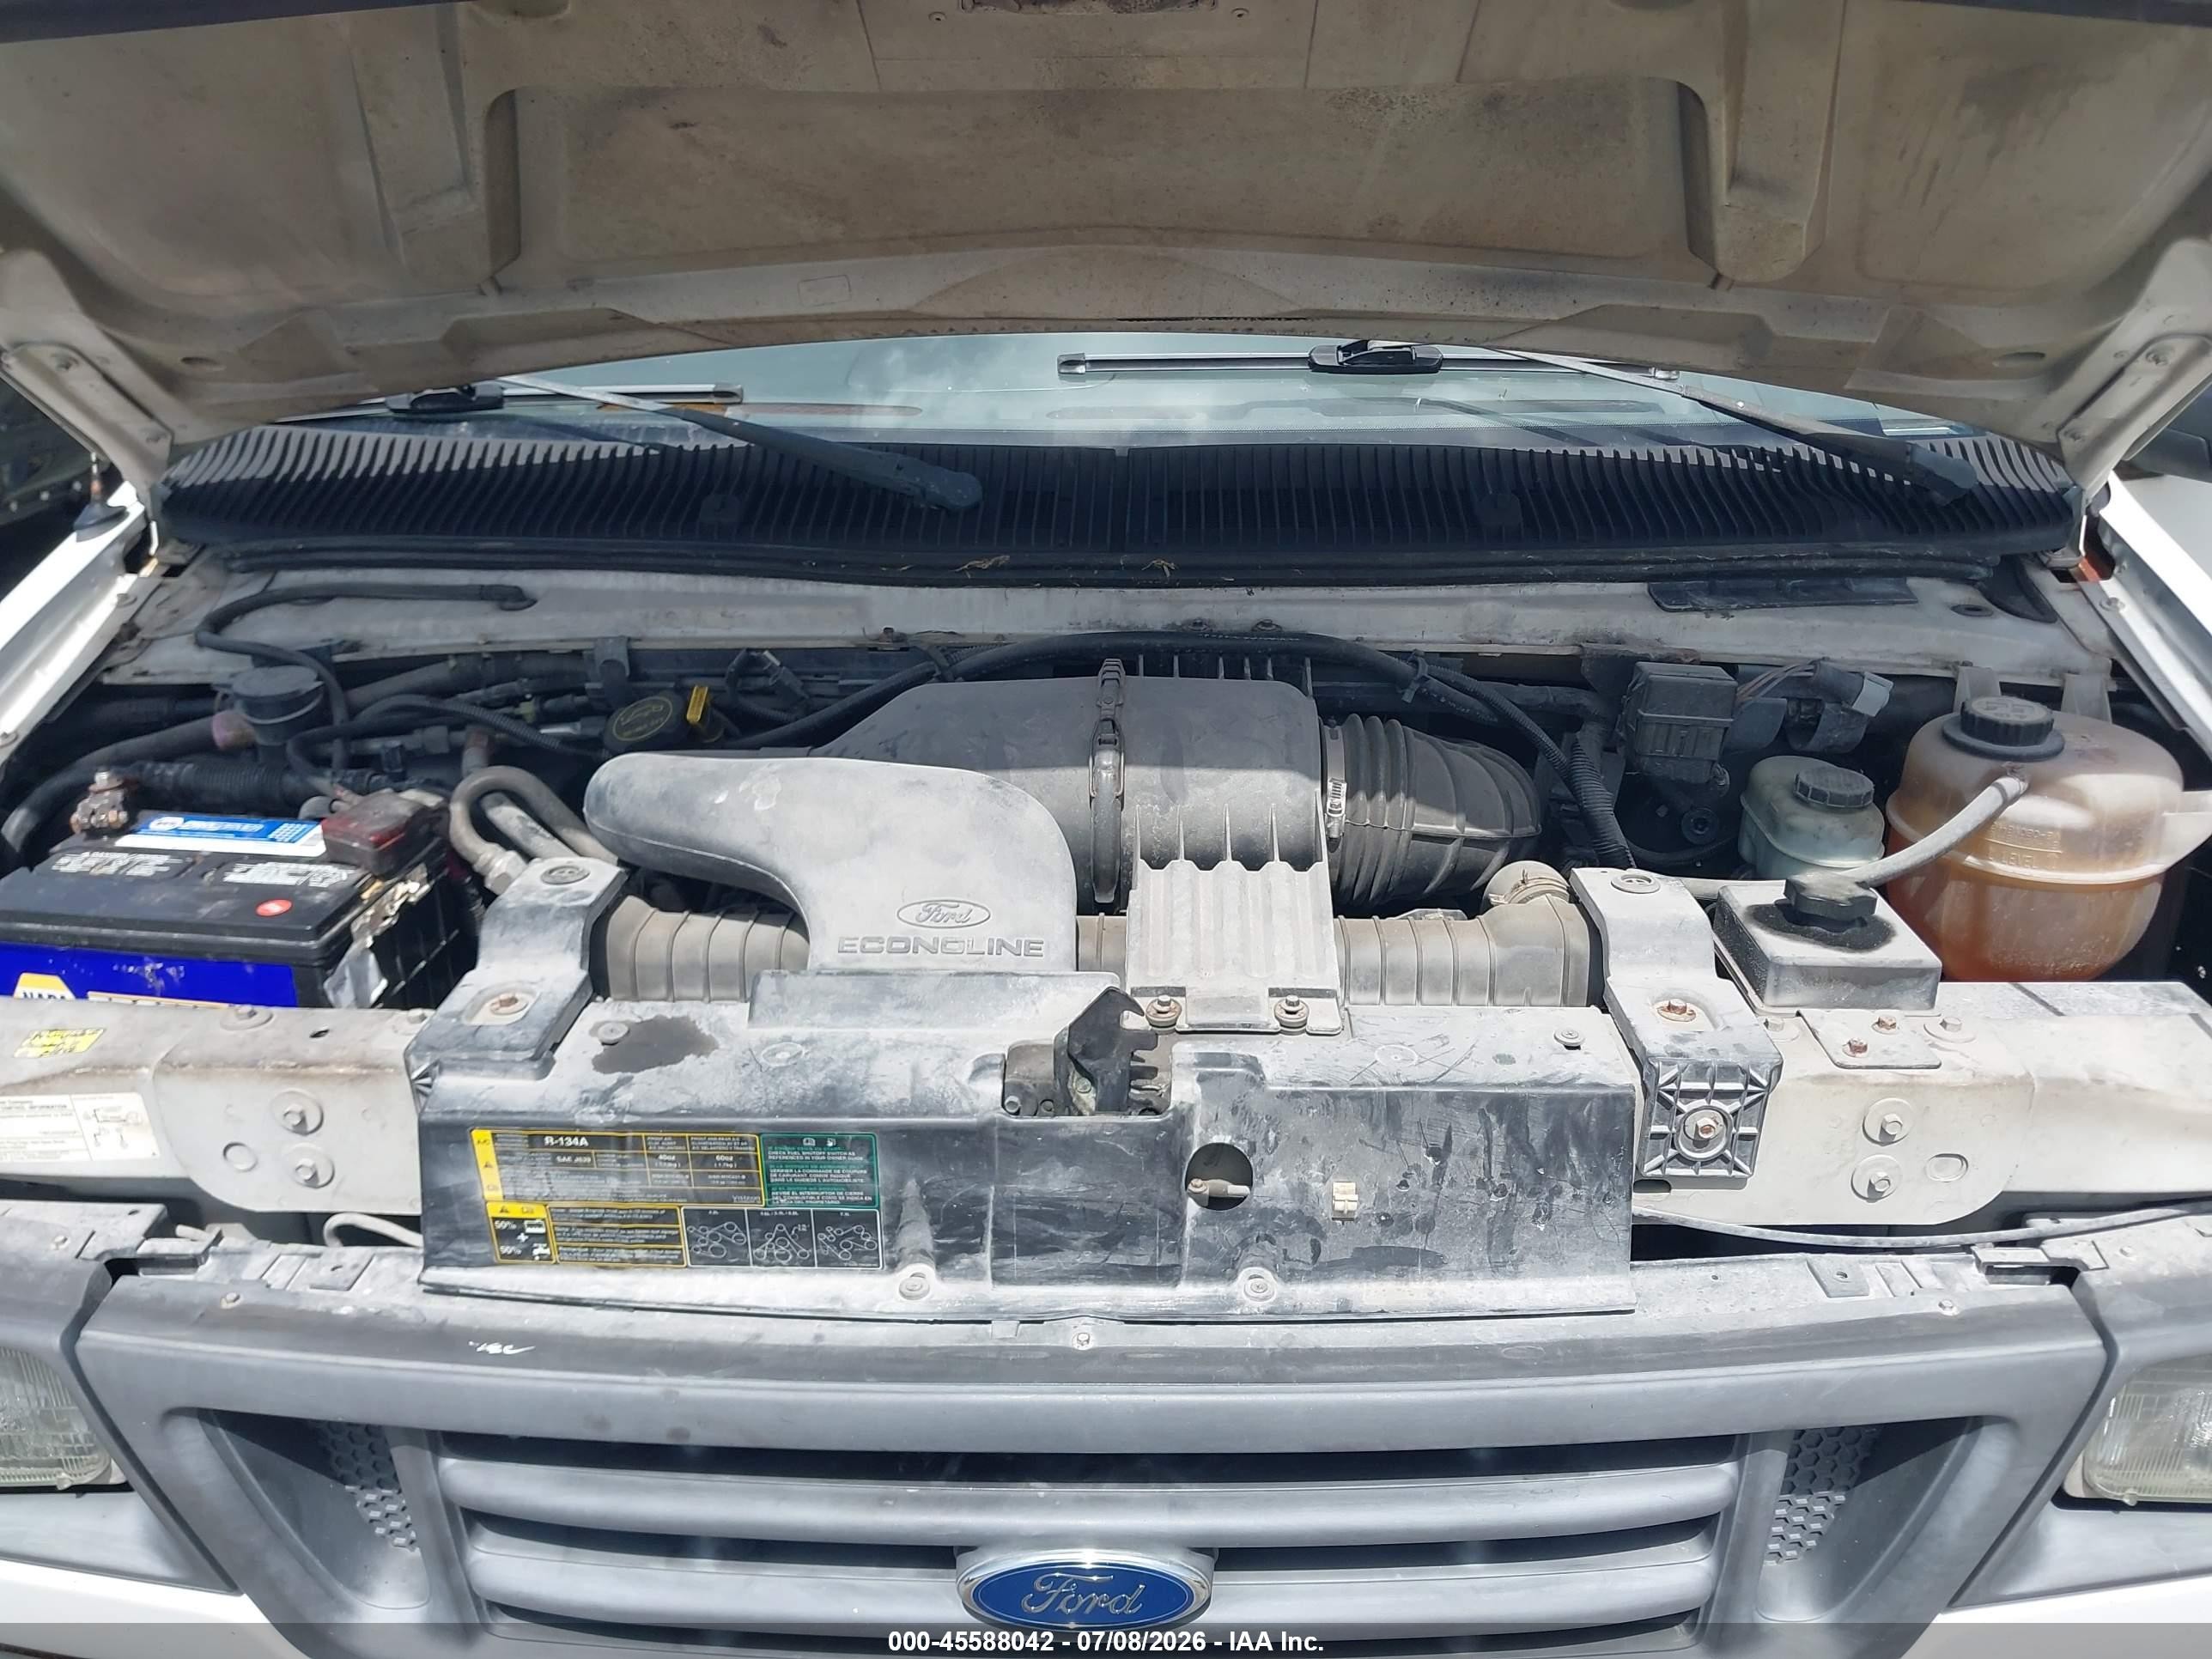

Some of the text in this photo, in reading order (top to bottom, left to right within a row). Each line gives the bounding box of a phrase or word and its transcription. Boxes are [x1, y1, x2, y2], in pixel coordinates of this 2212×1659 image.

[915, 902, 974, 923] Ford
[837, 936, 1044, 957] ECONOLINE
[544, 1136, 589, 1146] R-134A
[1021, 1572, 1146, 1615] Ford
